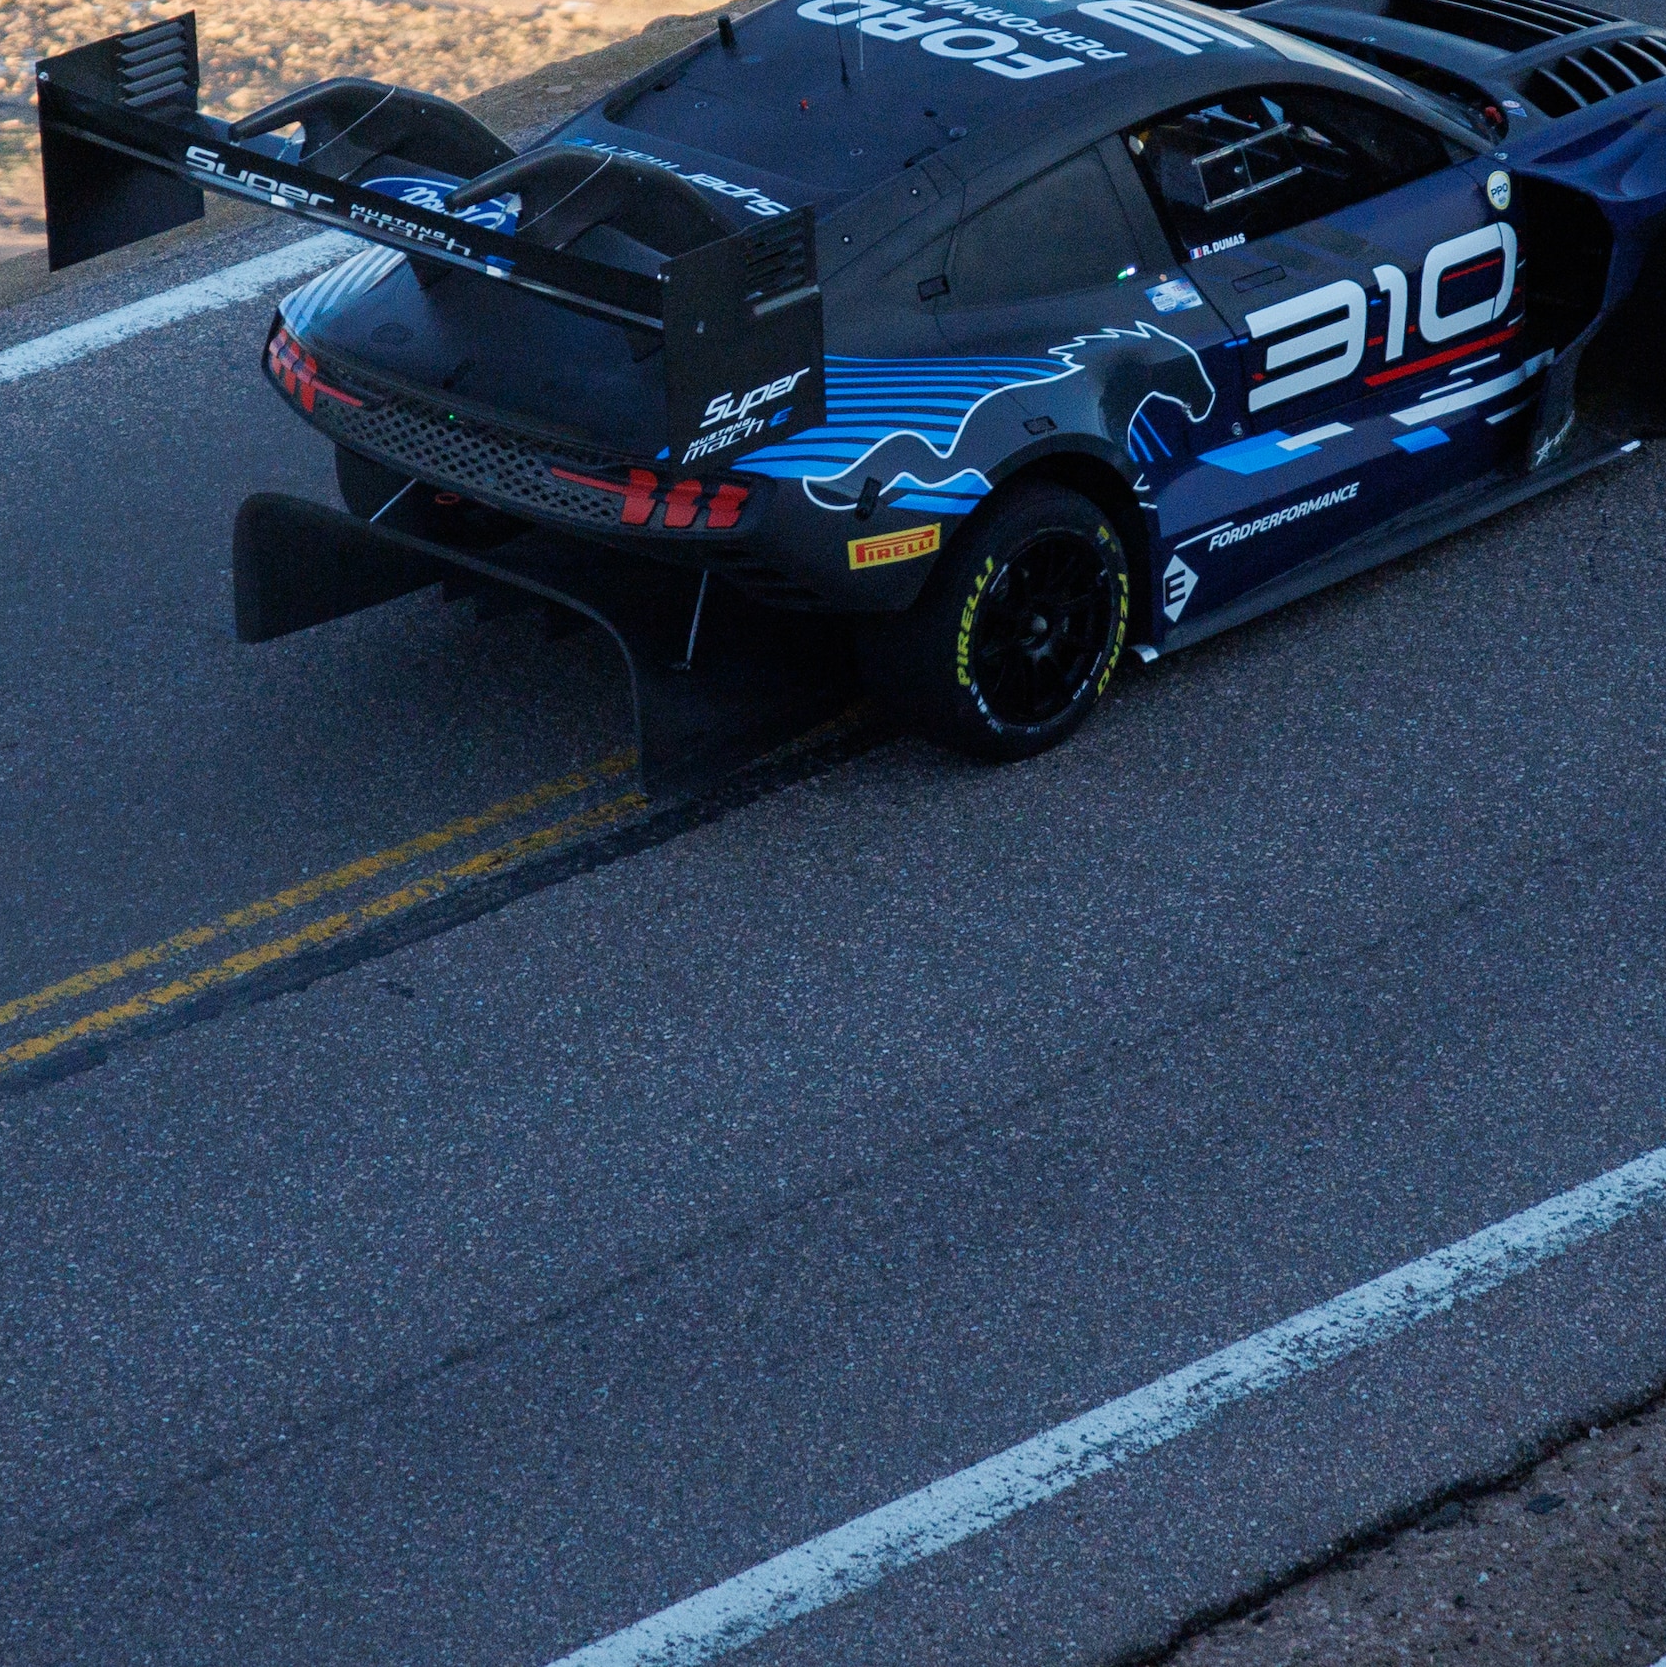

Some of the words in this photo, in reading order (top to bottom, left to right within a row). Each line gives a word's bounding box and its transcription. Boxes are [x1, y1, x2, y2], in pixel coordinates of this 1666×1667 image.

[186, 145, 334, 207] Super
[350, 203, 446, 238] MUSTANG
[1244, 221, 1518, 414] 310
[699, 367, 810, 428] Super
[688, 417, 753, 449] MUSTANG
[855, 529, 935, 563] PIRELLI
[957, 555, 994, 686] PIRELLI
